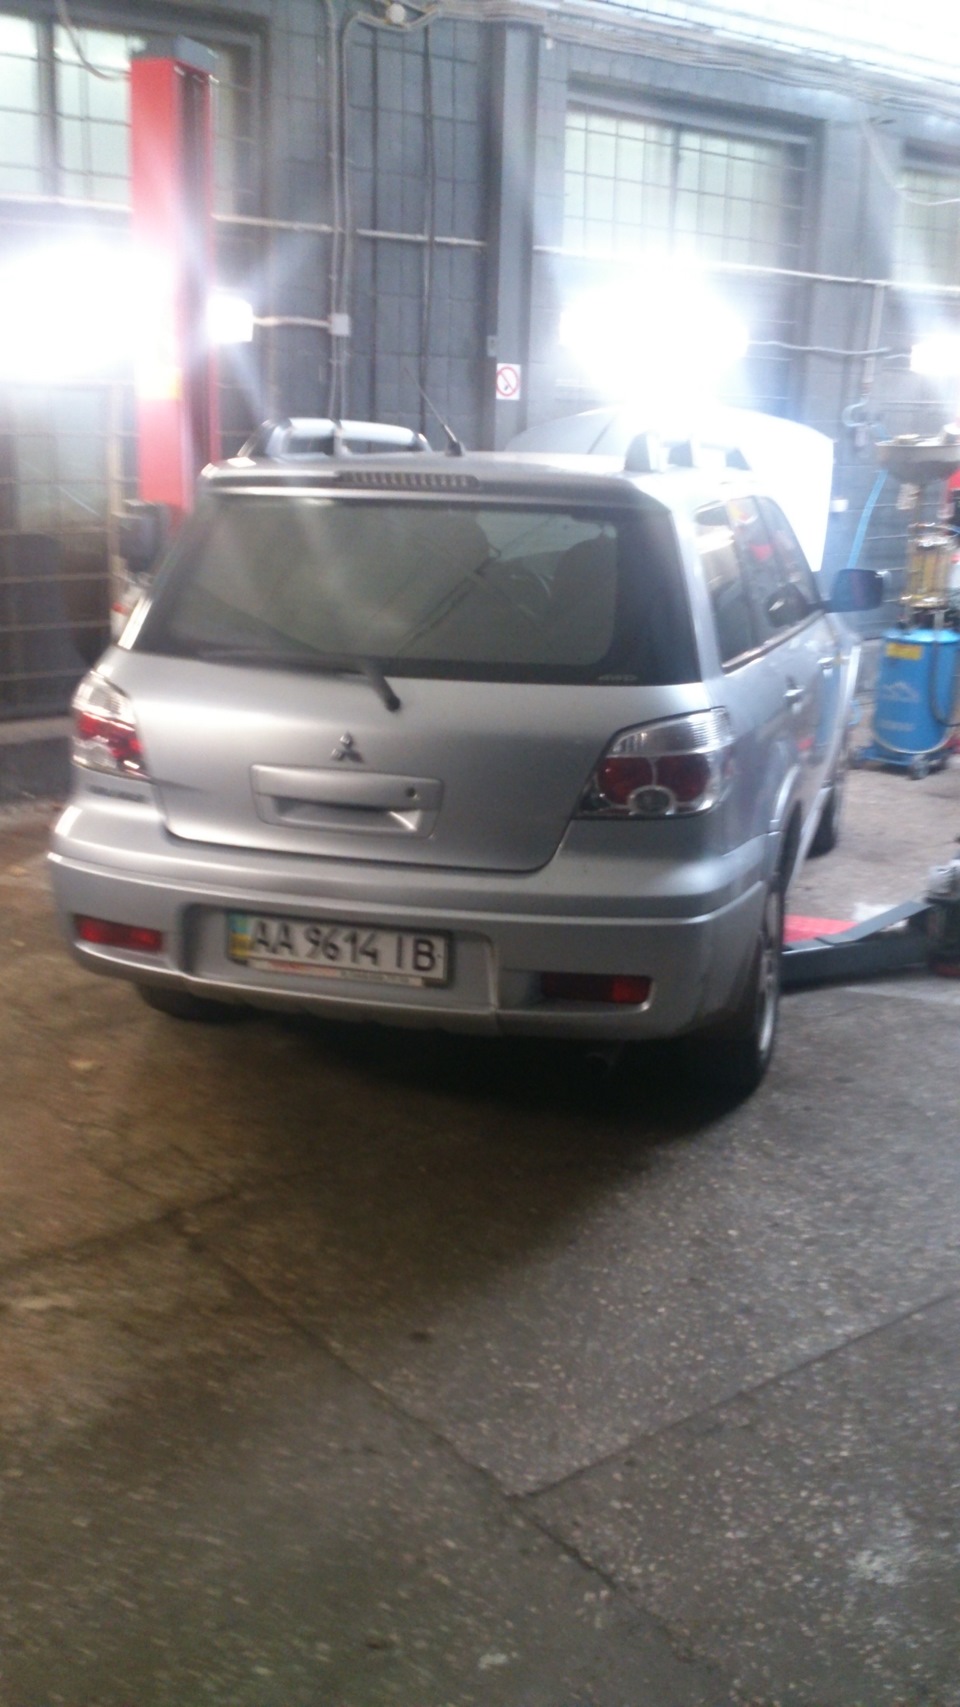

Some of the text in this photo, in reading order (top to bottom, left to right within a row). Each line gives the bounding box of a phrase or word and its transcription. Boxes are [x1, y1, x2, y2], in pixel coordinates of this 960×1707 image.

[253, 920, 436, 972] AA 9614 IB
